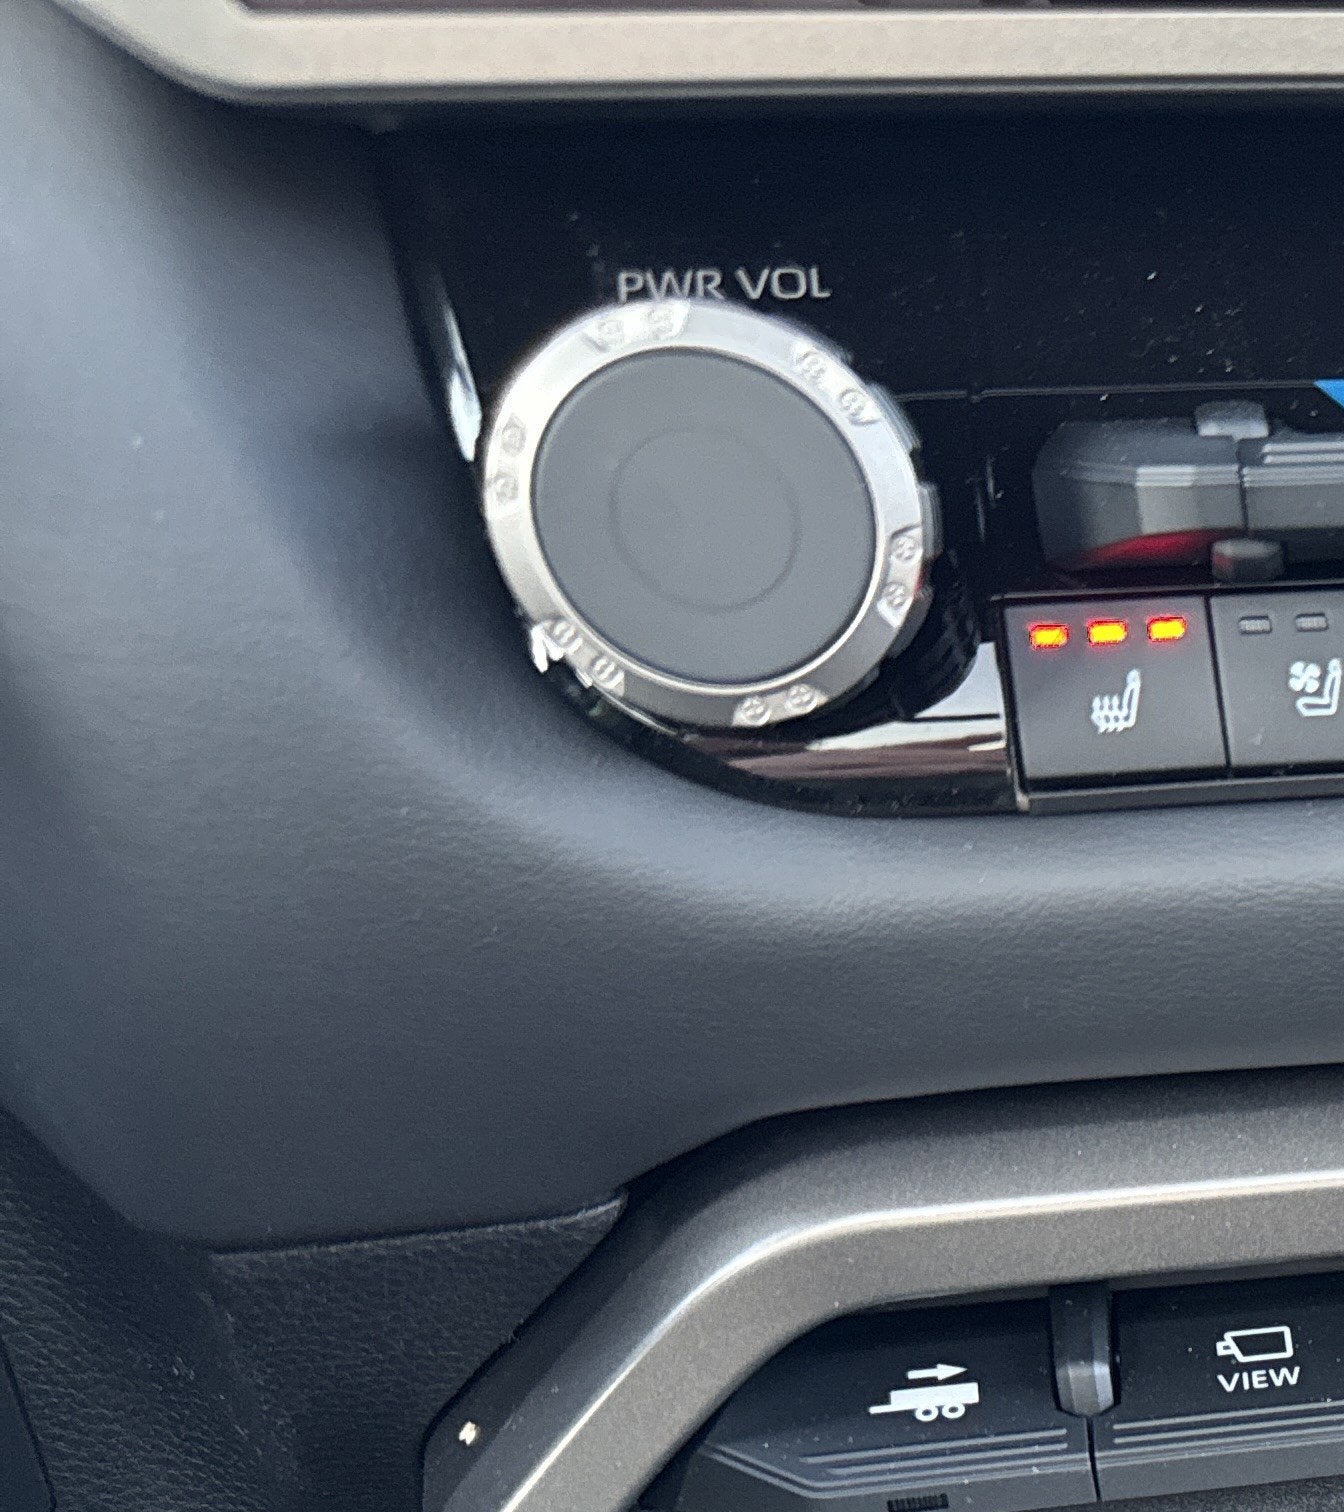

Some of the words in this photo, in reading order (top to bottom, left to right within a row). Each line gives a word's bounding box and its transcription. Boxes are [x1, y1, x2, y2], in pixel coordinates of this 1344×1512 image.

[616, 269, 724, 302] PWR
[736, 266, 833, 299] VOL
[1217, 1366, 1300, 1393] VIEW
